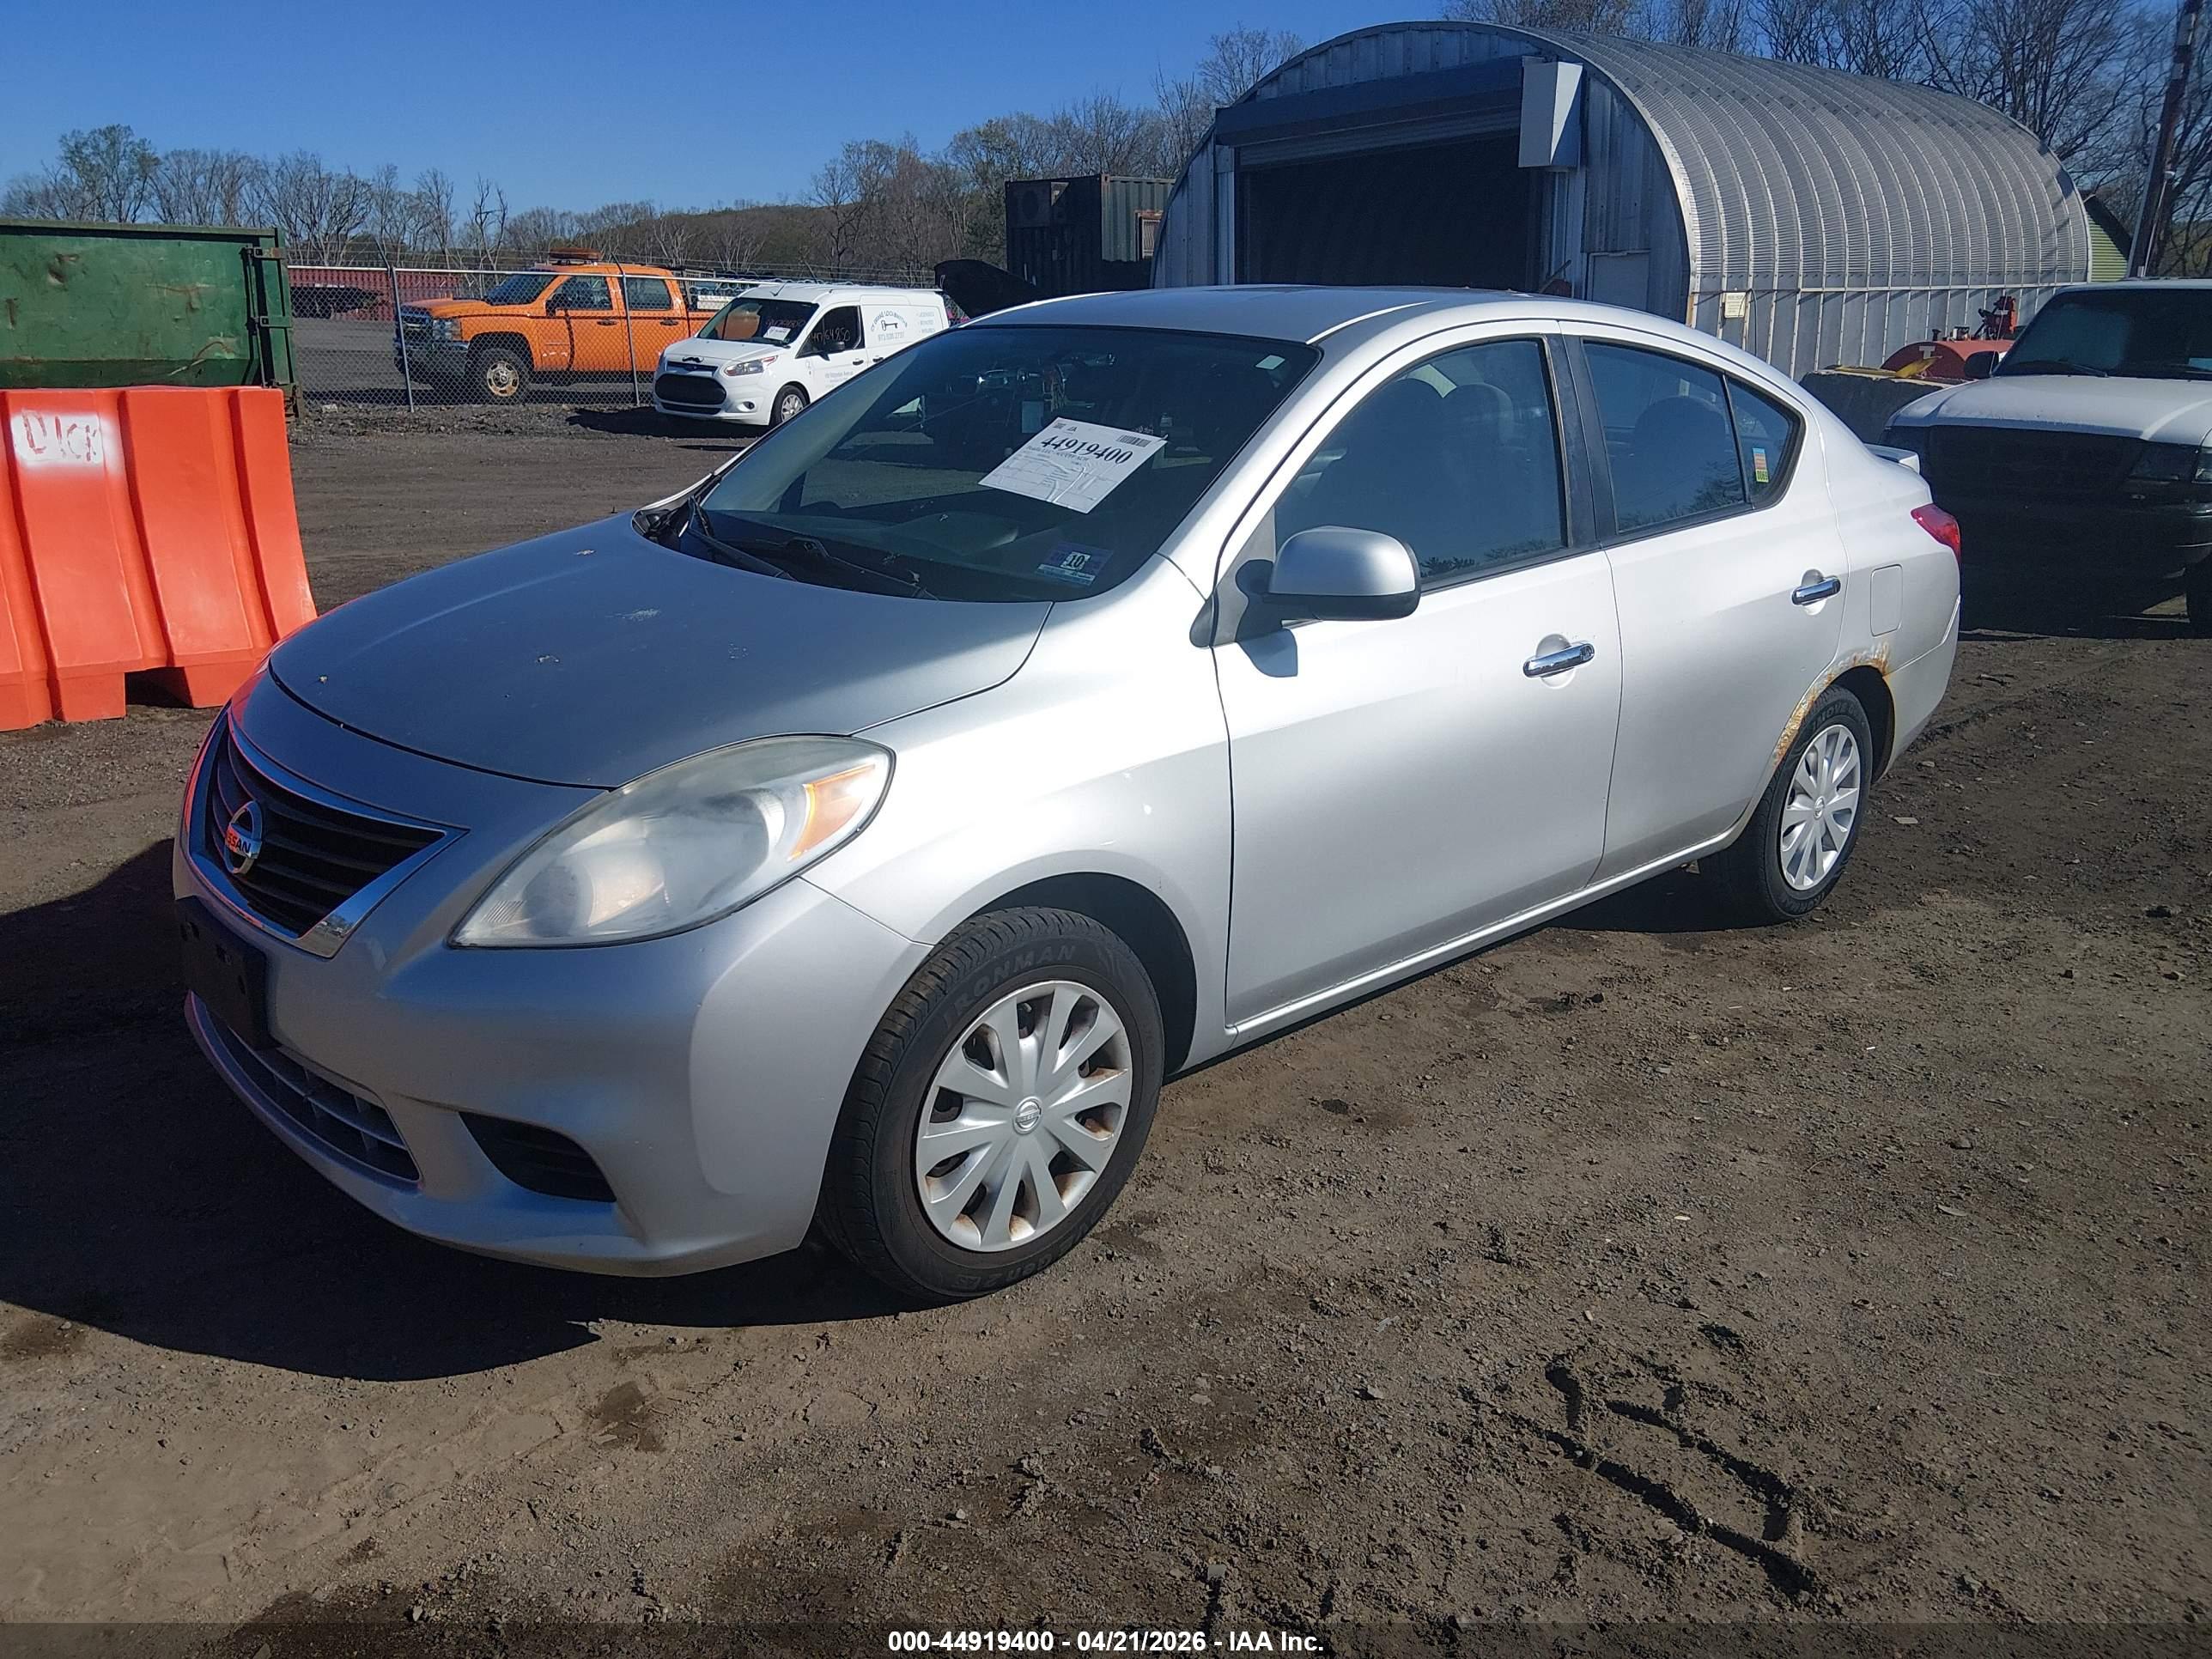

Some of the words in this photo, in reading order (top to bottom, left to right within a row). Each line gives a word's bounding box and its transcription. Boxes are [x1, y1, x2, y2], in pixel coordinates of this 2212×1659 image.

[1041, 435, 1133, 464] 44919400
[1067, 555, 1085, 568] 10
[227, 831, 252, 854] SSAN
